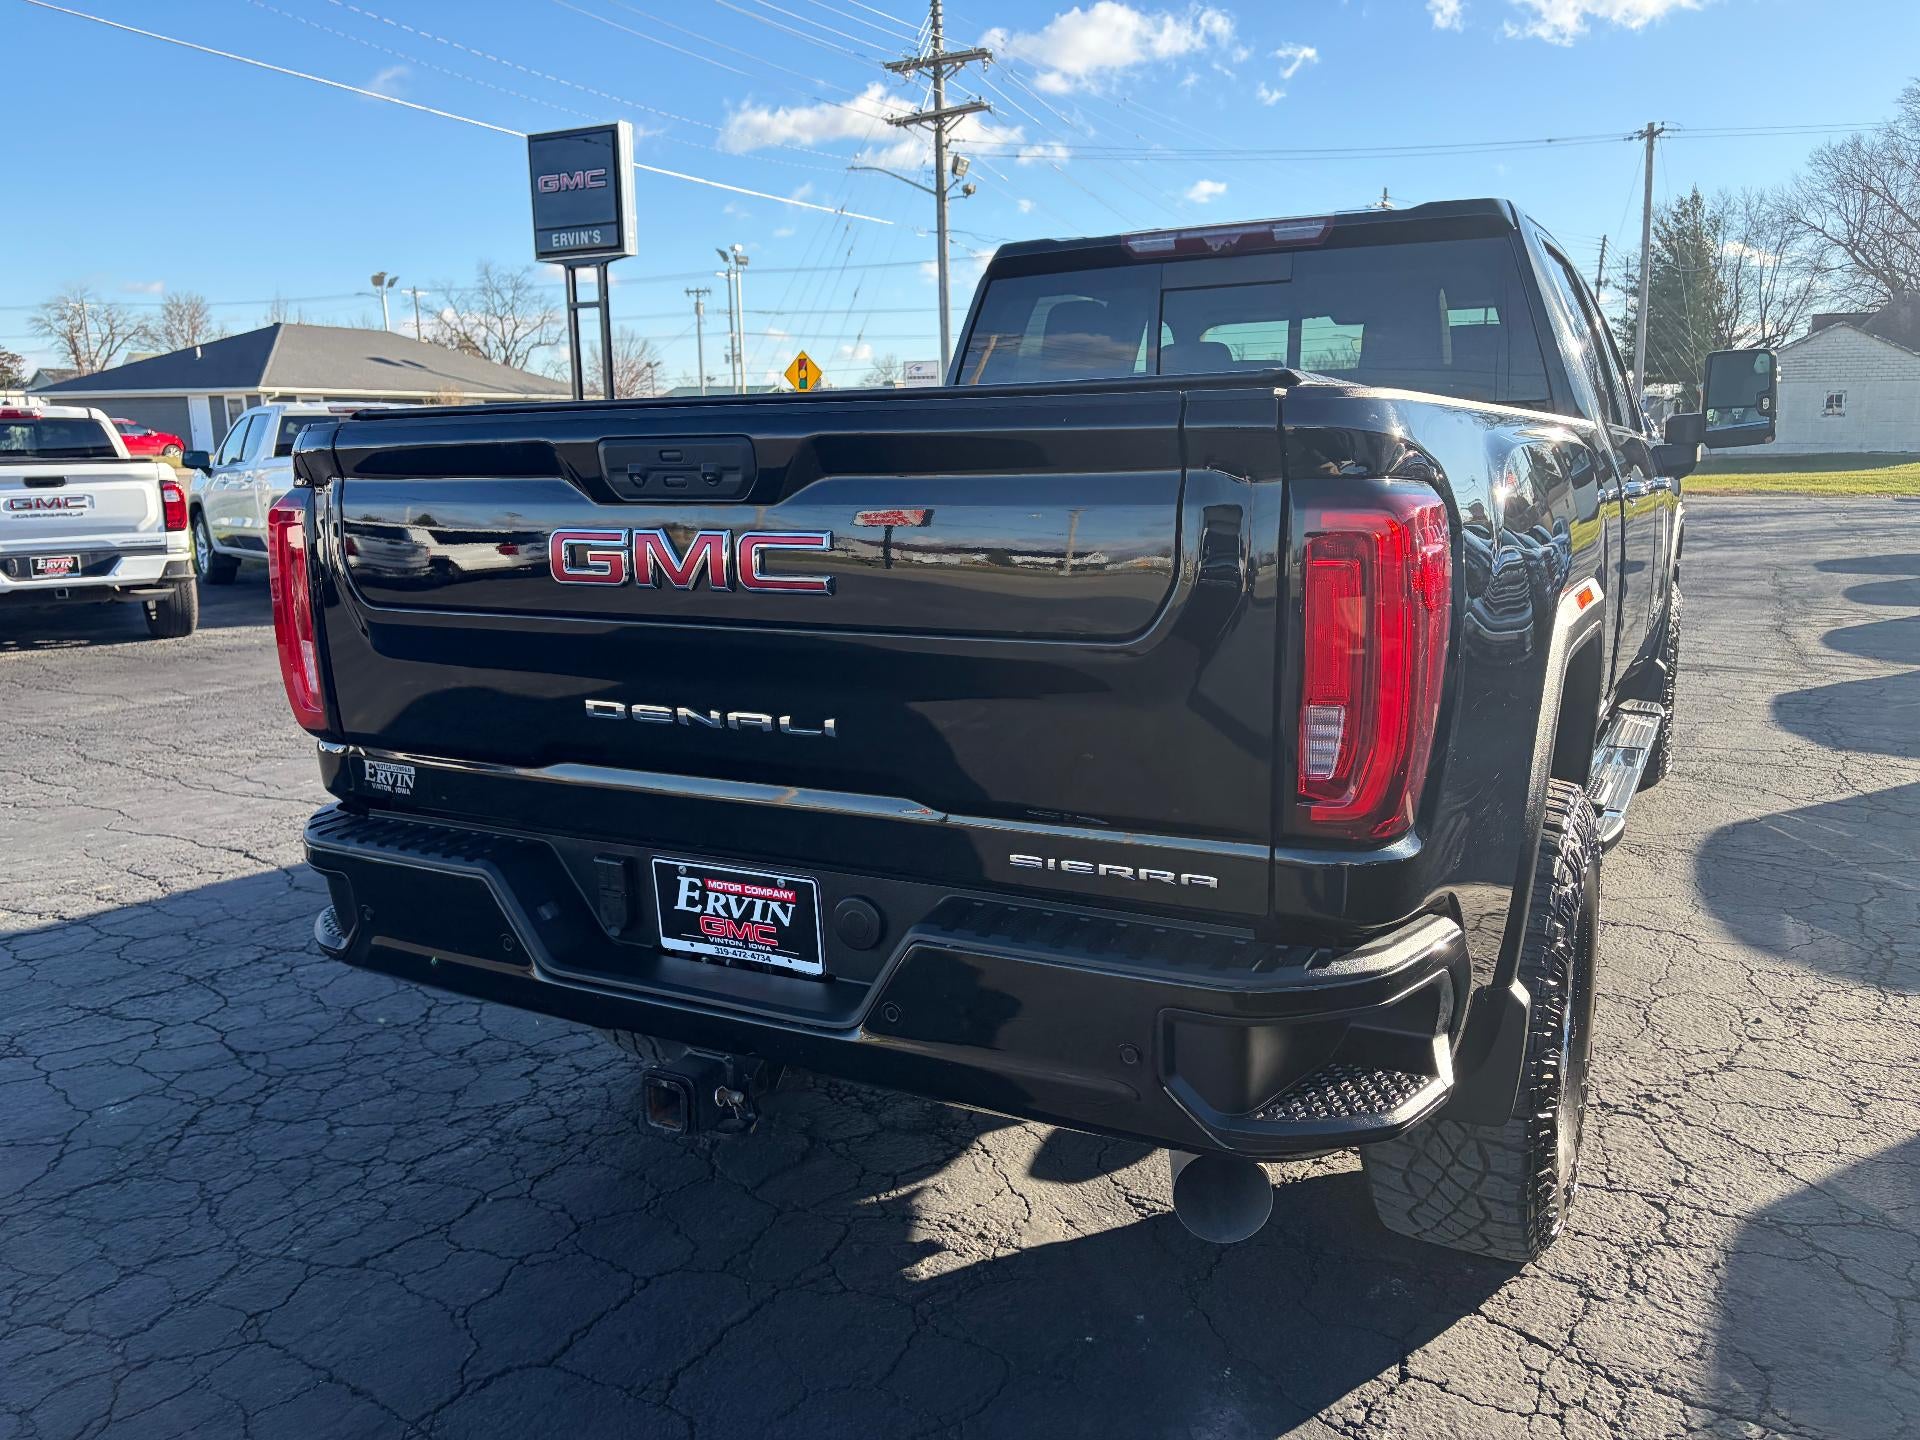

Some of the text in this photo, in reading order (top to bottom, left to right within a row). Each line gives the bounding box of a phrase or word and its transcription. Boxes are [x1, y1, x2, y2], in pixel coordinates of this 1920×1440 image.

[537, 169, 606, 193] GMC
[552, 230, 601, 247] ERVIN'S
[9, 495, 87, 511] GMC
[549, 527, 836, 597] GMC
[585, 699, 837, 738] DENALI
[364, 760, 416, 789] ERVIN
[1009, 854, 1218, 889] SIERRA
[673, 875, 796, 927] ERVIN
[707, 880, 794, 900] MOTOR COMPANY
[699, 915, 779, 947] GMC
[708, 936, 773, 952] VINTON, IOWA
[714, 946, 772, 963] 319-472-4734
